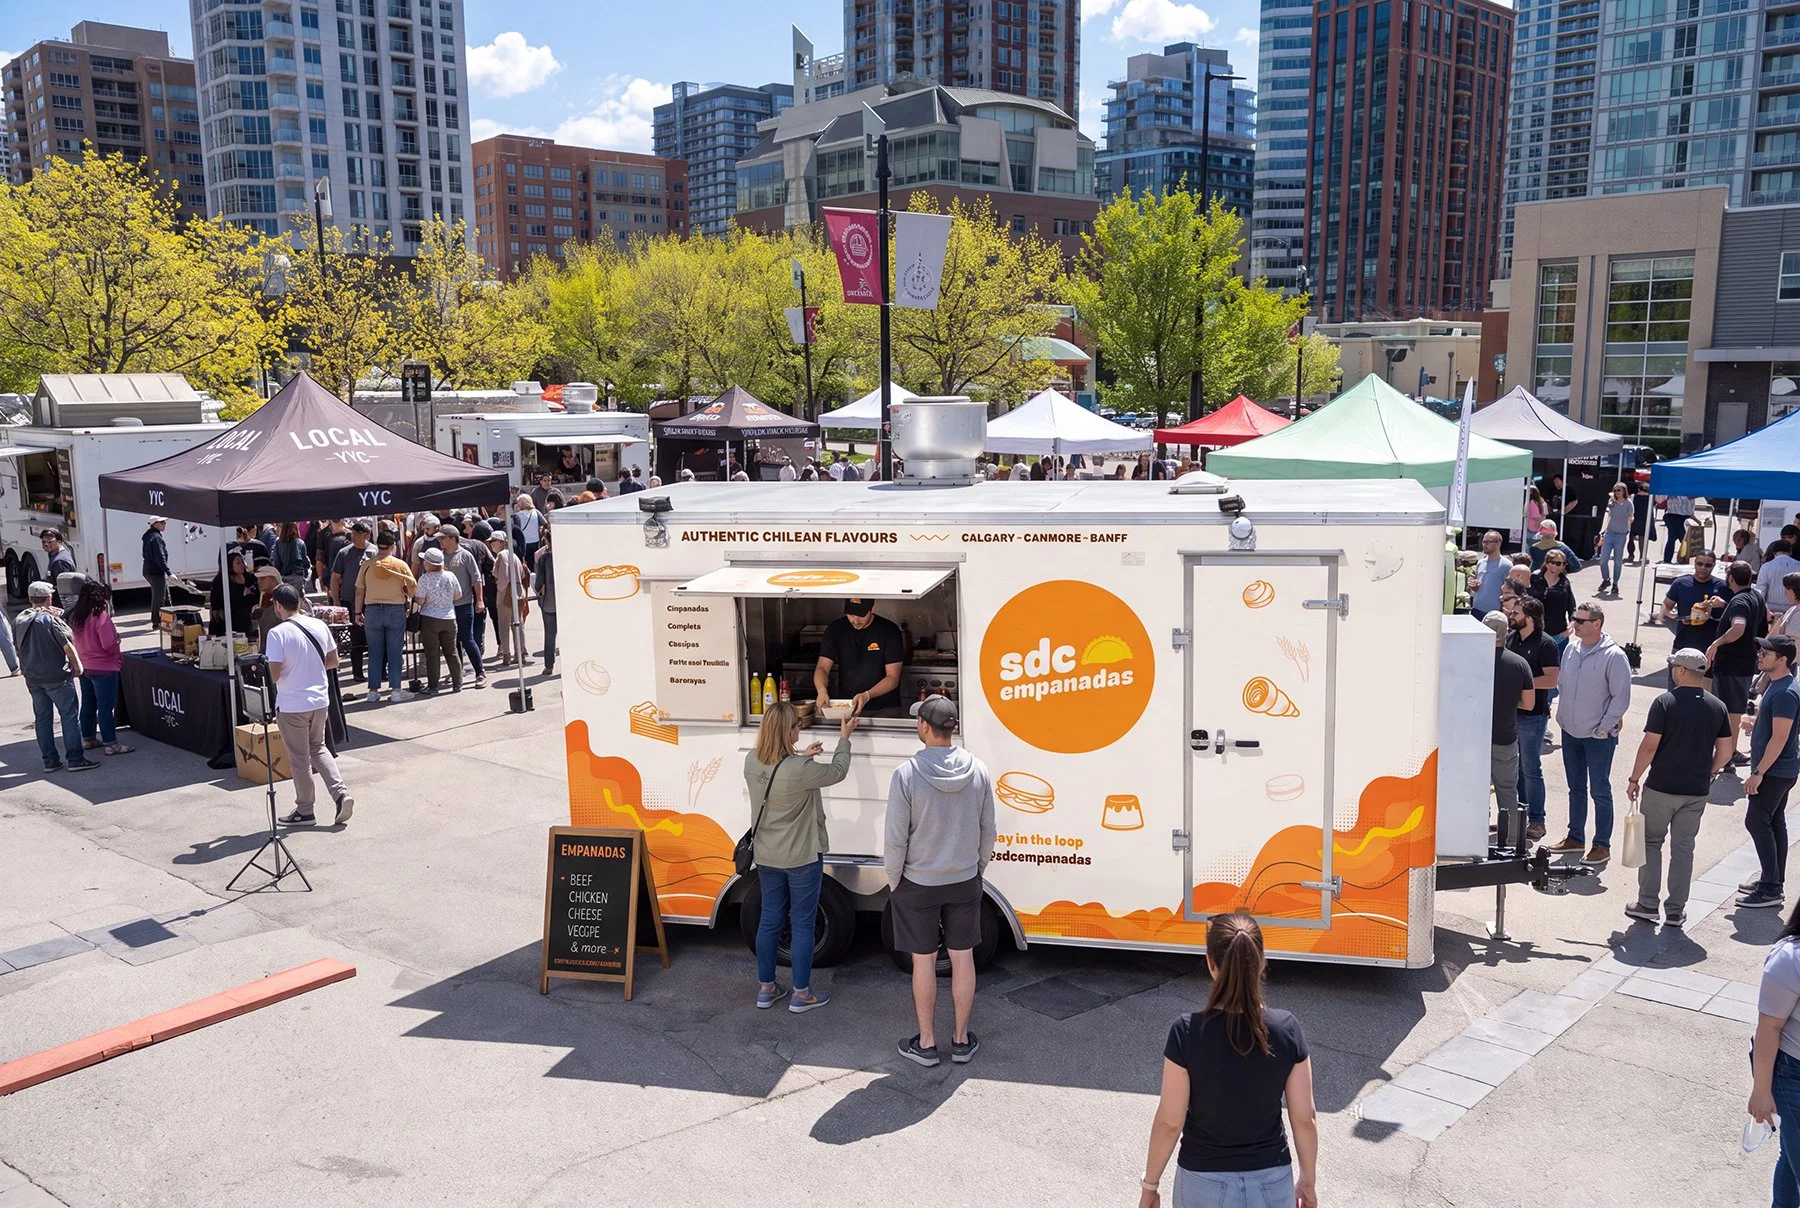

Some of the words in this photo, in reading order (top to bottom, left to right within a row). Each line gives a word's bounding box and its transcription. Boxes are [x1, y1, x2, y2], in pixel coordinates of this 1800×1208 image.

[205, 429, 263, 451] LOCAL
[289, 427, 387, 450] LOCAL
[149, 490, 165, 507] YYC
[358, 490, 392, 507] YYC
[681, 531, 760, 542] AUTHENTIC
[762, 531, 822, 543] CHILEAN
[825, 532, 898, 543] FLAVOURS
[961, 533, 1015, 543] CALGARY
[1023, 533, 1082, 543] CANMORE
[1090, 533, 1128, 543] BANFF
[999, 637, 1077, 682] sdc
[1000, 668, 1134, 702] empanadas
[151, 686, 185, 714] LOCAL
[1015, 833, 1028, 844] in
[1030, 834, 1052, 845] the
[1055, 835, 1084, 850] loop
[561, 844, 626, 859] EMPANADAS
[570, 873, 593, 887] BEEF
[568, 890, 609, 904] CHICKEN
[567, 907, 603, 921] CHEESE
[570, 941, 579, 953] &
[581, 943, 607, 954] more
